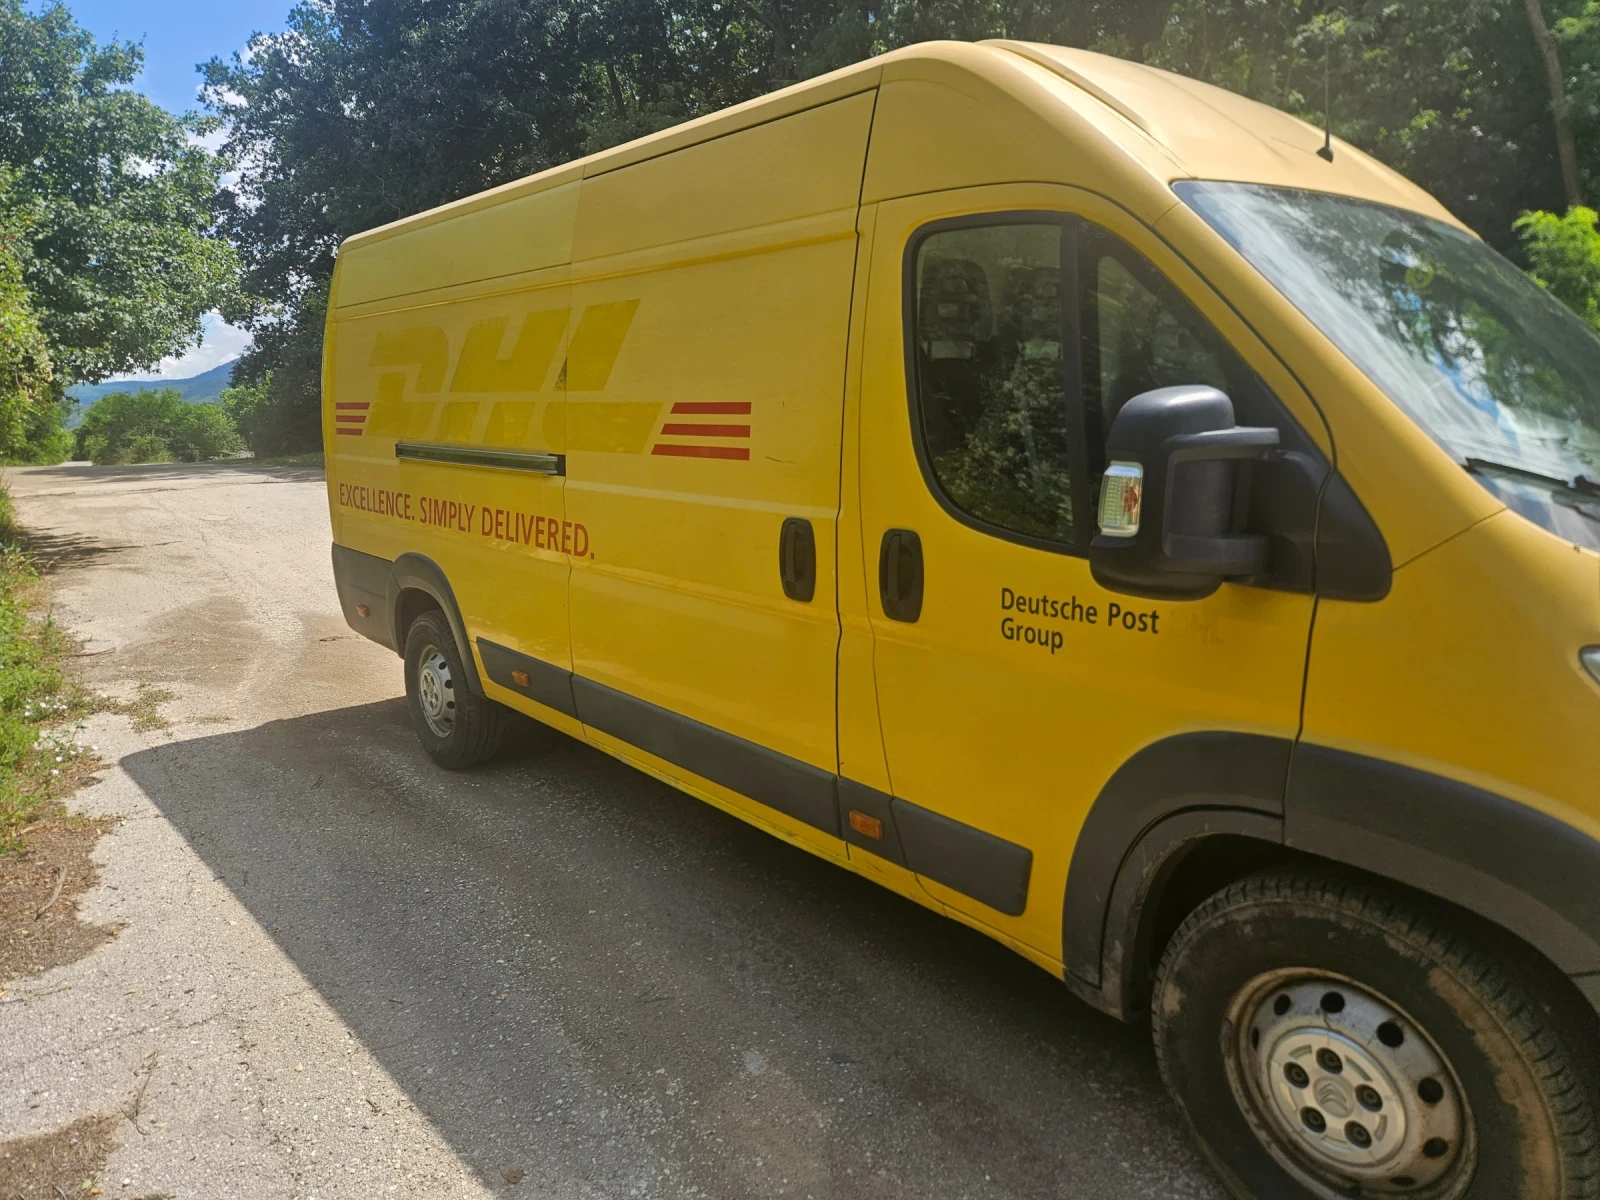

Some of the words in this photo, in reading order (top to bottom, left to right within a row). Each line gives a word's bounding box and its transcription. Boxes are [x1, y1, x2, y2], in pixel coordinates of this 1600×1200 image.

[366, 299, 663, 454] DHL
[339, 482, 415, 521] EXCELLENCE.
[419, 496, 475, 533] SIMPLY
[481, 506, 595, 560] DELIVERED.
[1001, 587, 1098, 624] Deutsche
[1107, 602, 1160, 634] Post
[1001, 617, 1063, 654] Group
